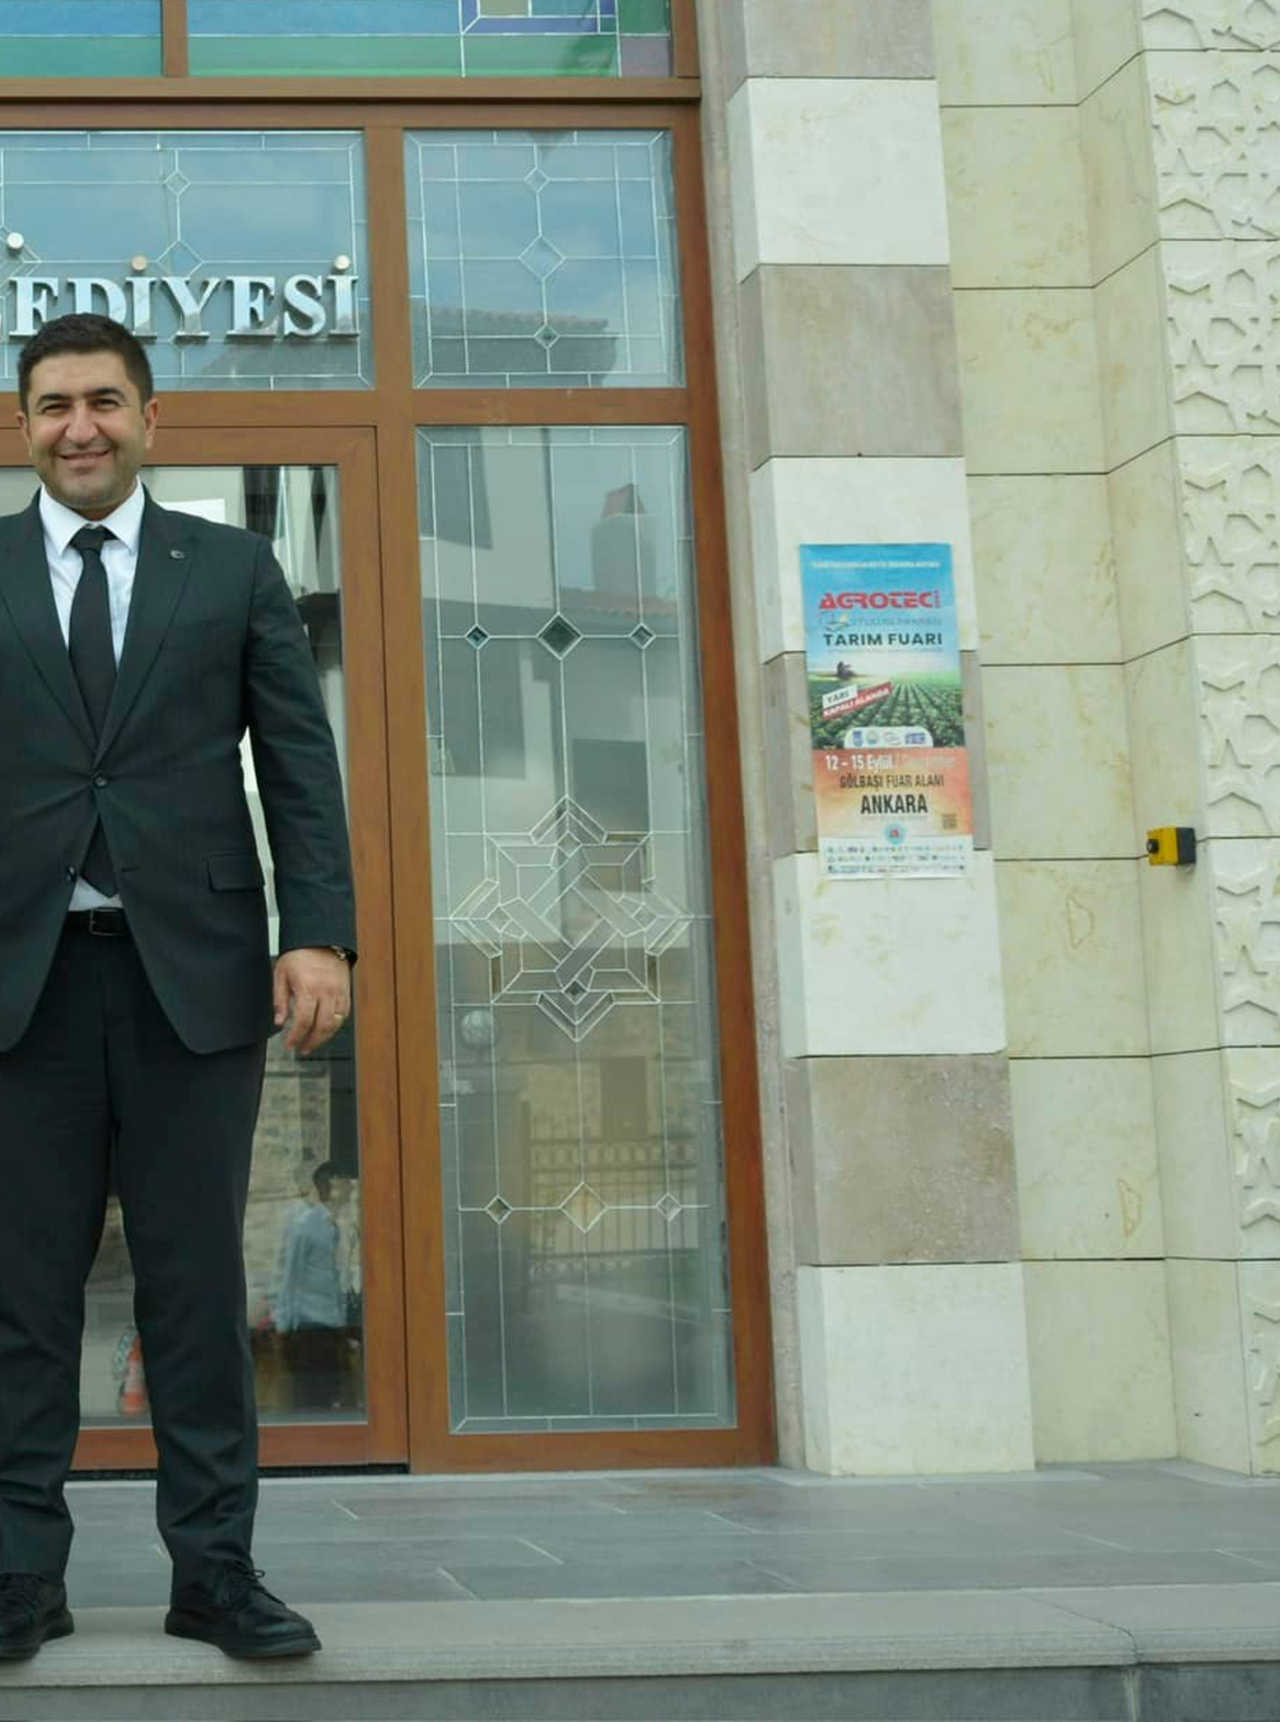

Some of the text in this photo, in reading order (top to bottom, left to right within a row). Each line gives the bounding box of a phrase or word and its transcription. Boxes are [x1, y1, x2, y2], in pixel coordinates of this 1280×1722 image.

[819, 591, 933, 609] AGROTEC
[823, 632, 943, 646] TARIM FUARI
[825, 754, 839, 770] 12
[851, 754, 865, 770] 15
[860, 793, 928, 814] ANKARA
